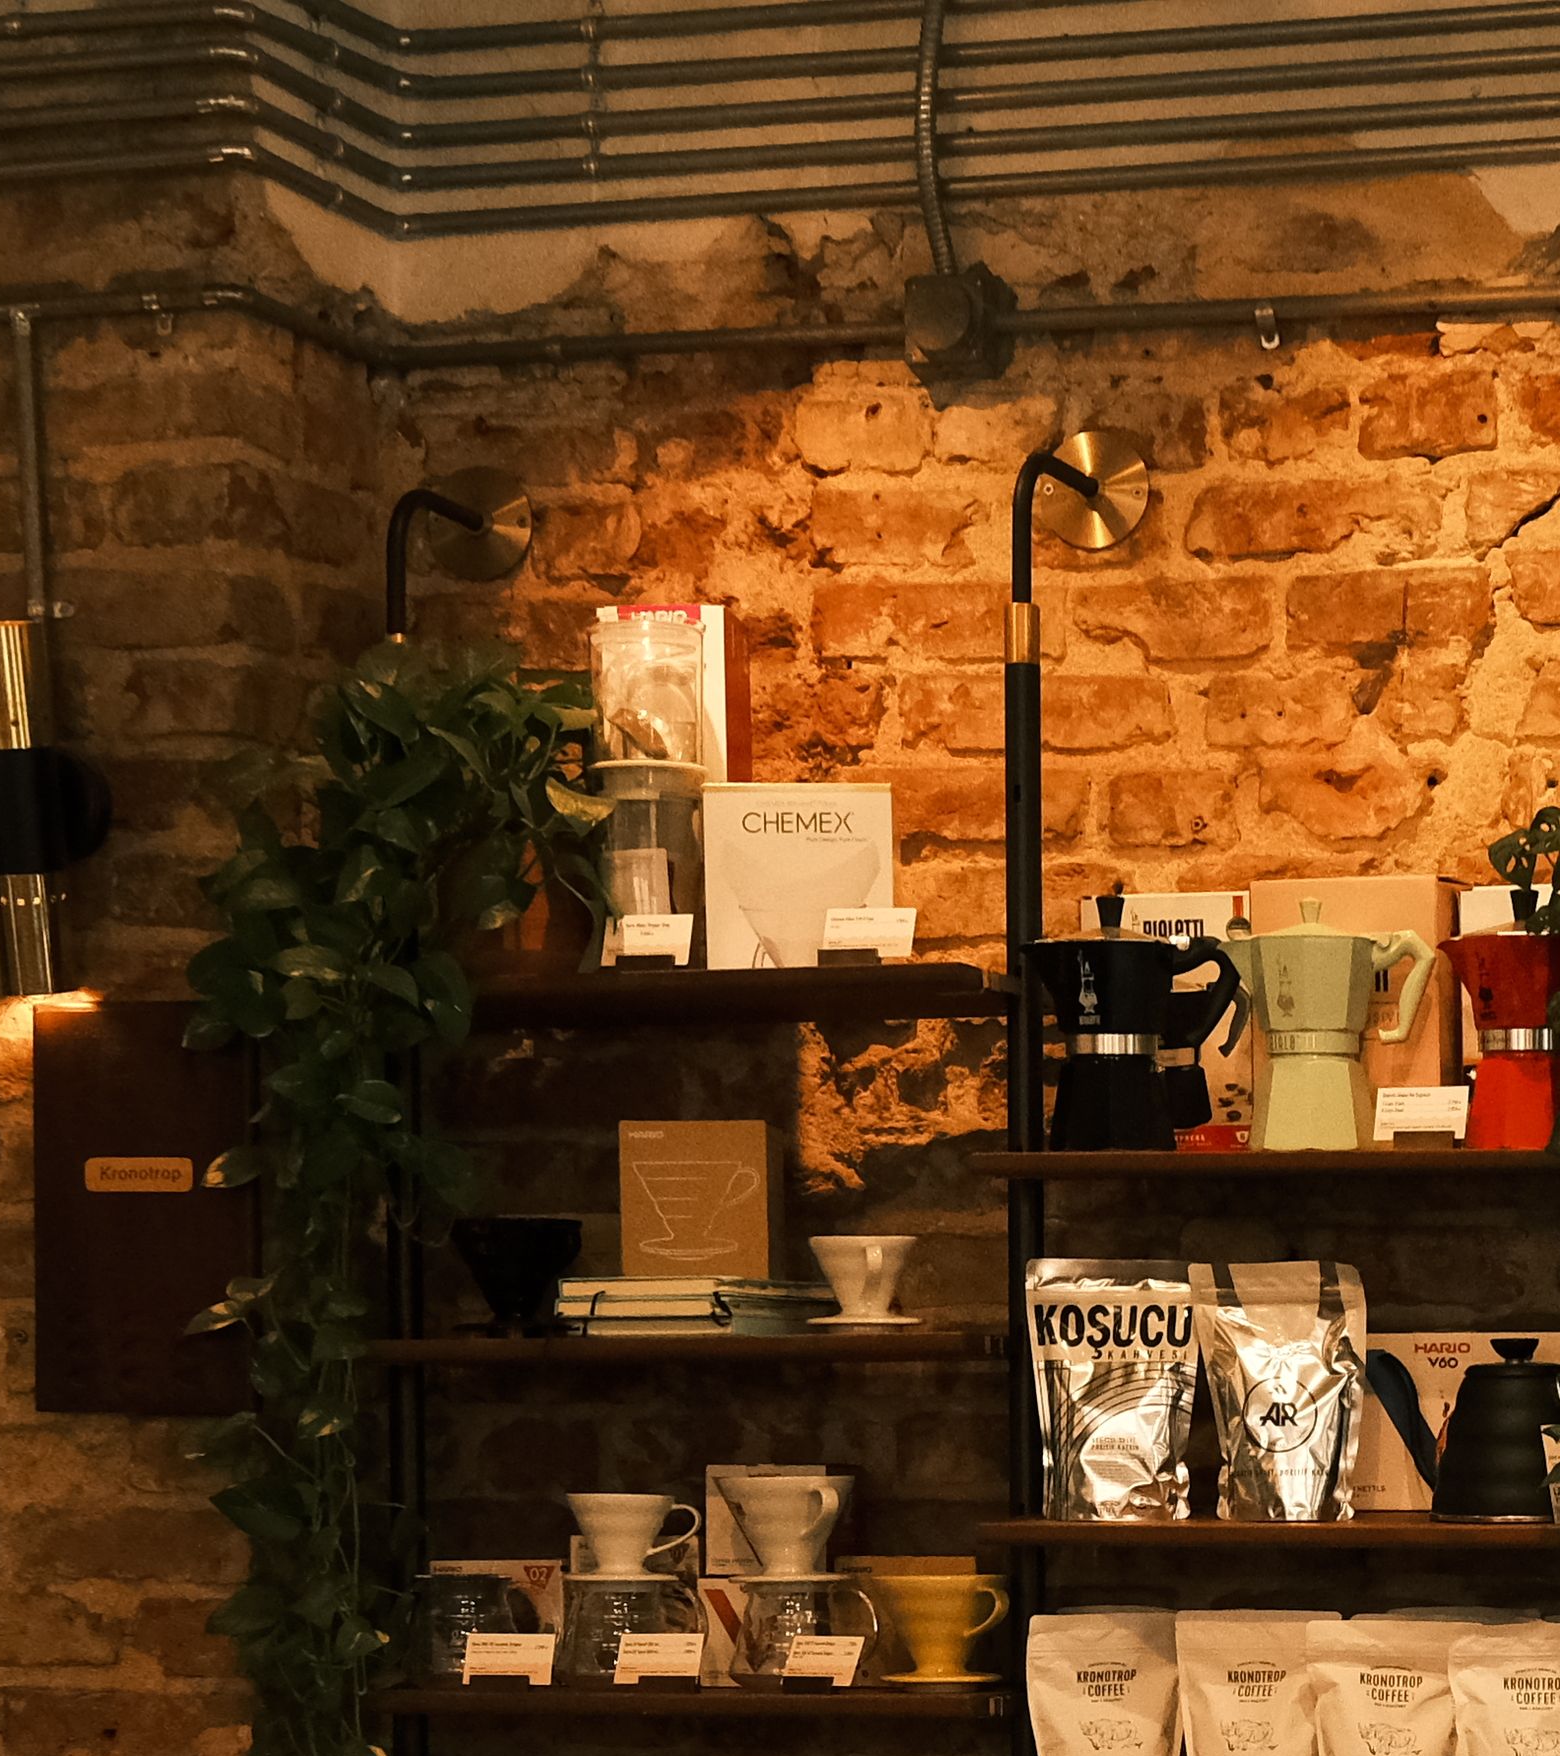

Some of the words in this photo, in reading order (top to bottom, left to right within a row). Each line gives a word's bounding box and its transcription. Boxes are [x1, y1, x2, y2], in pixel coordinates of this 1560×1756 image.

[742, 811, 854, 834] CHEMEX
[100, 1166, 182, 1183] Kronotrop
[1034, 1303, 1193, 1360] KOŞUCU
[1414, 1342, 1471, 1353] HARIO
[1427, 1357, 1459, 1368] V60
[529, 1567, 548, 1581] 02
[1077, 1668, 1137, 1683] KRONOTROP
[1227, 1669, 1287, 1683] KRONOTROP
[1359, 1672, 1423, 1689] KRONOTROP
[1087, 1684, 1126, 1698] COFFEE
[1237, 1685, 1275, 1698] COFFEE
[1371, 1688, 1410, 1703] COFFEE
[1516, 1691, 1557, 1706] COFFEE
